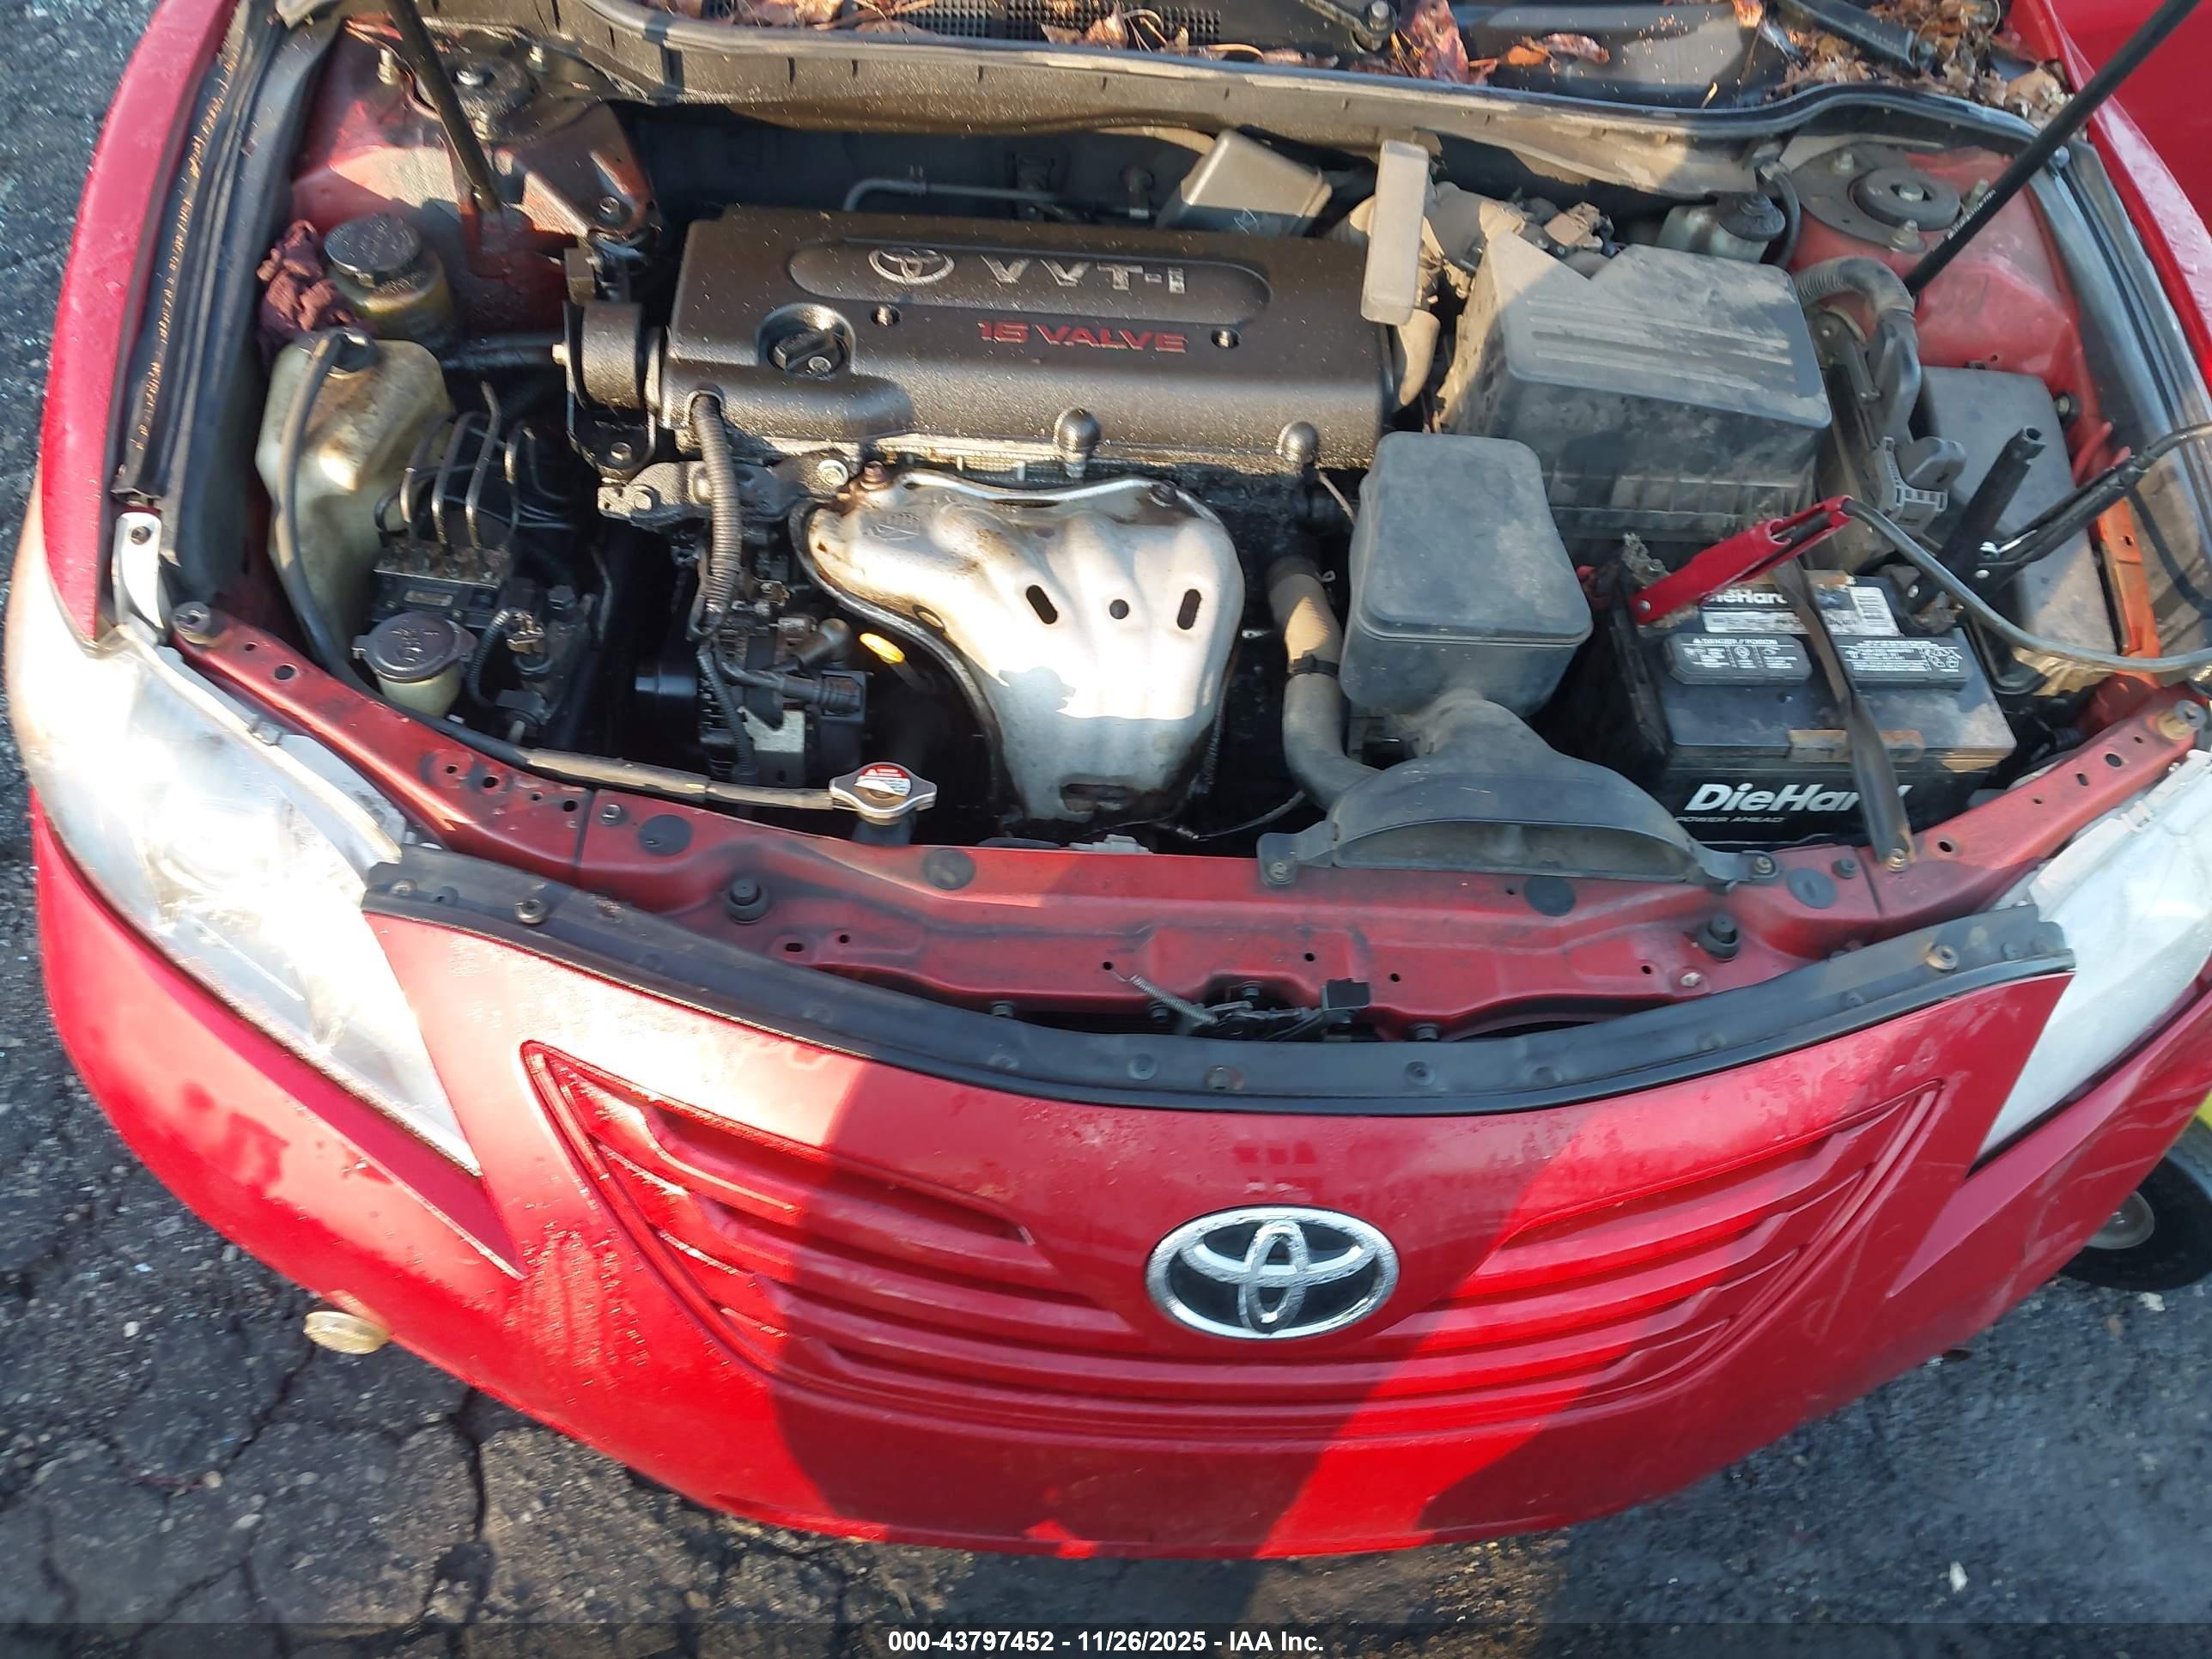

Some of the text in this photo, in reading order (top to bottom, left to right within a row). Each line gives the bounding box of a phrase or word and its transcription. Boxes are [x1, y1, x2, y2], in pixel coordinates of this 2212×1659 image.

[977, 321, 1189, 353] 16 VALVE
[1684, 782, 1913, 811] DieHar
